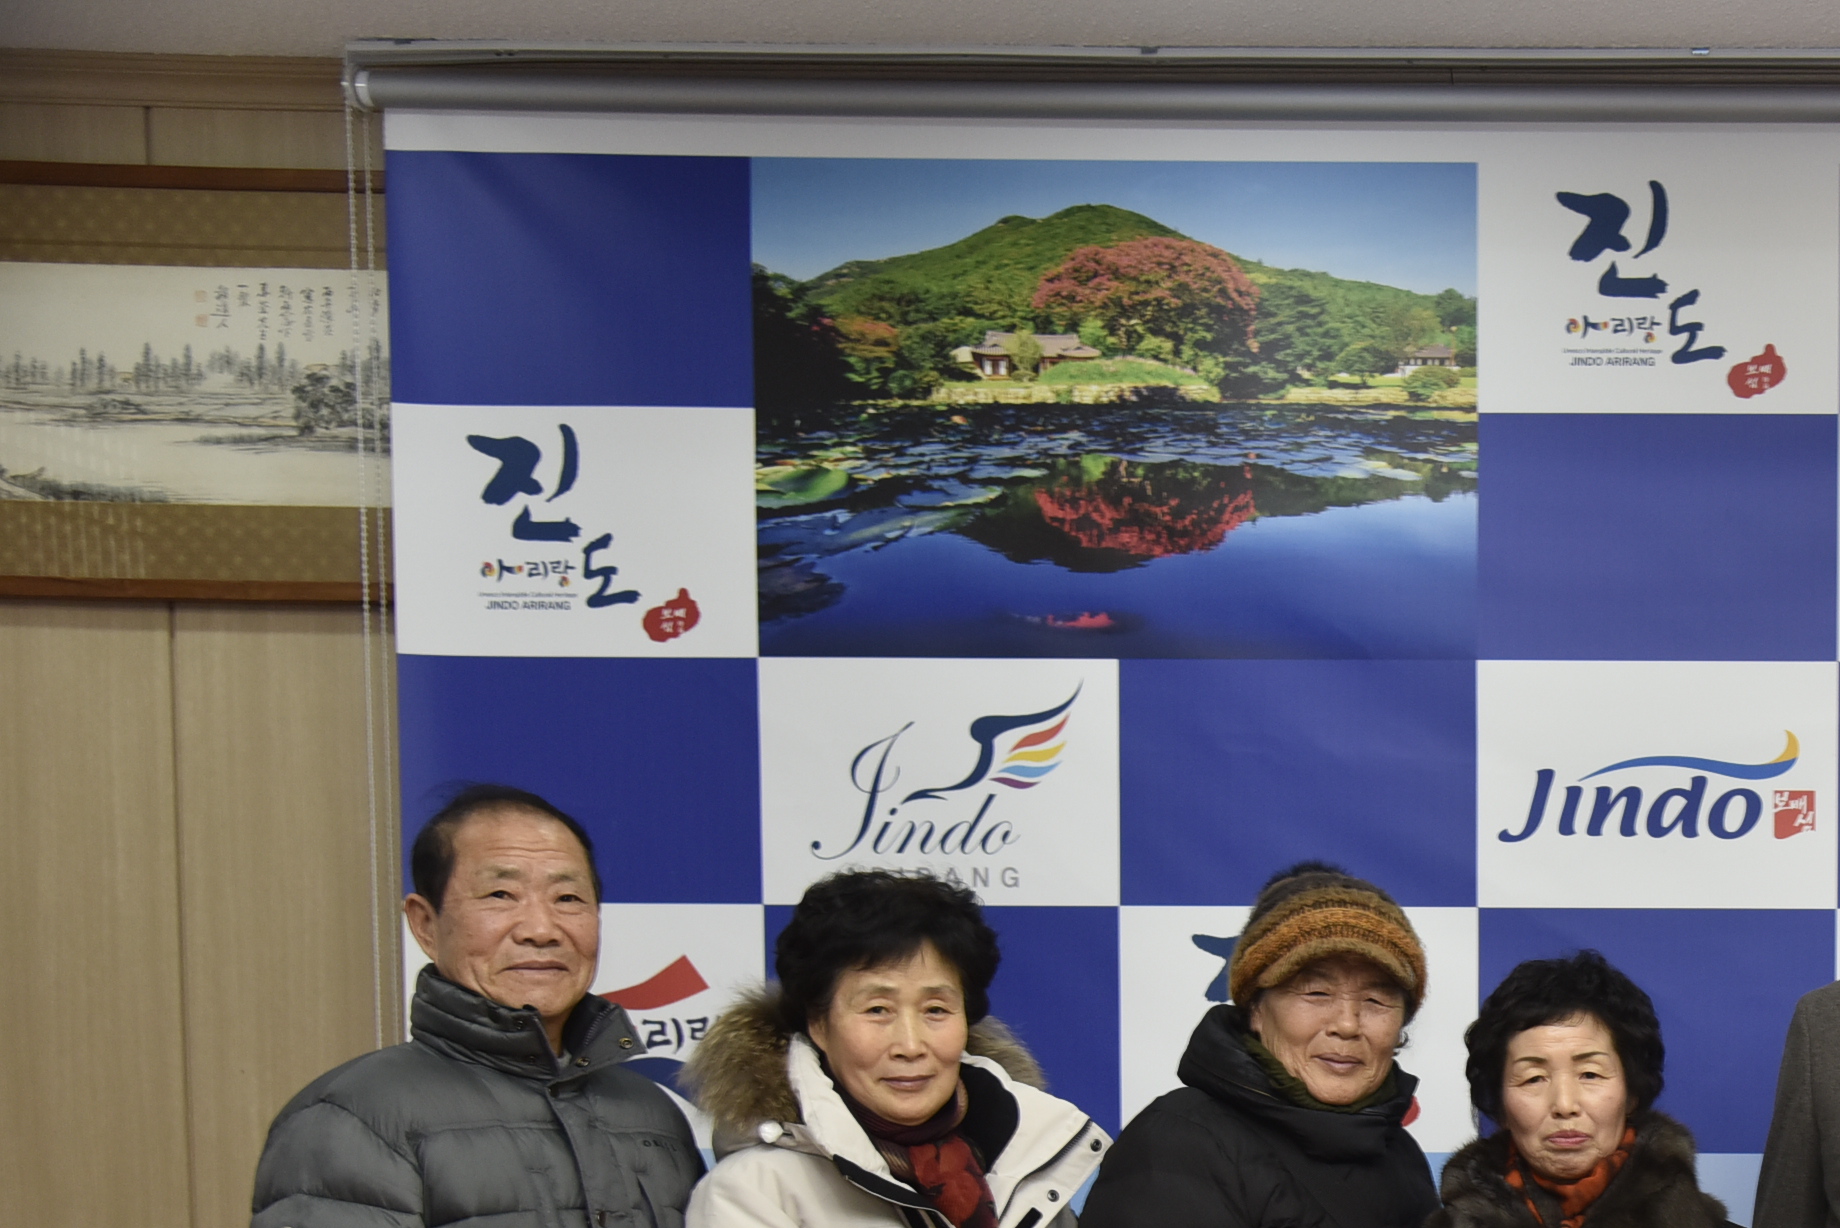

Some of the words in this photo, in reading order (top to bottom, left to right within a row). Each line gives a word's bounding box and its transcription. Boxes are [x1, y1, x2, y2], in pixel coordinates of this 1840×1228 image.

[1569, 356, 1604, 366] JINDO
[1605, 356, 1656, 366] ARIRANG
[485, 600, 520, 610] JINDO
[522, 600, 572, 610] ARIRANG
[809, 720, 1021, 860] Jindo
[1498, 768, 1764, 843] Jindo
